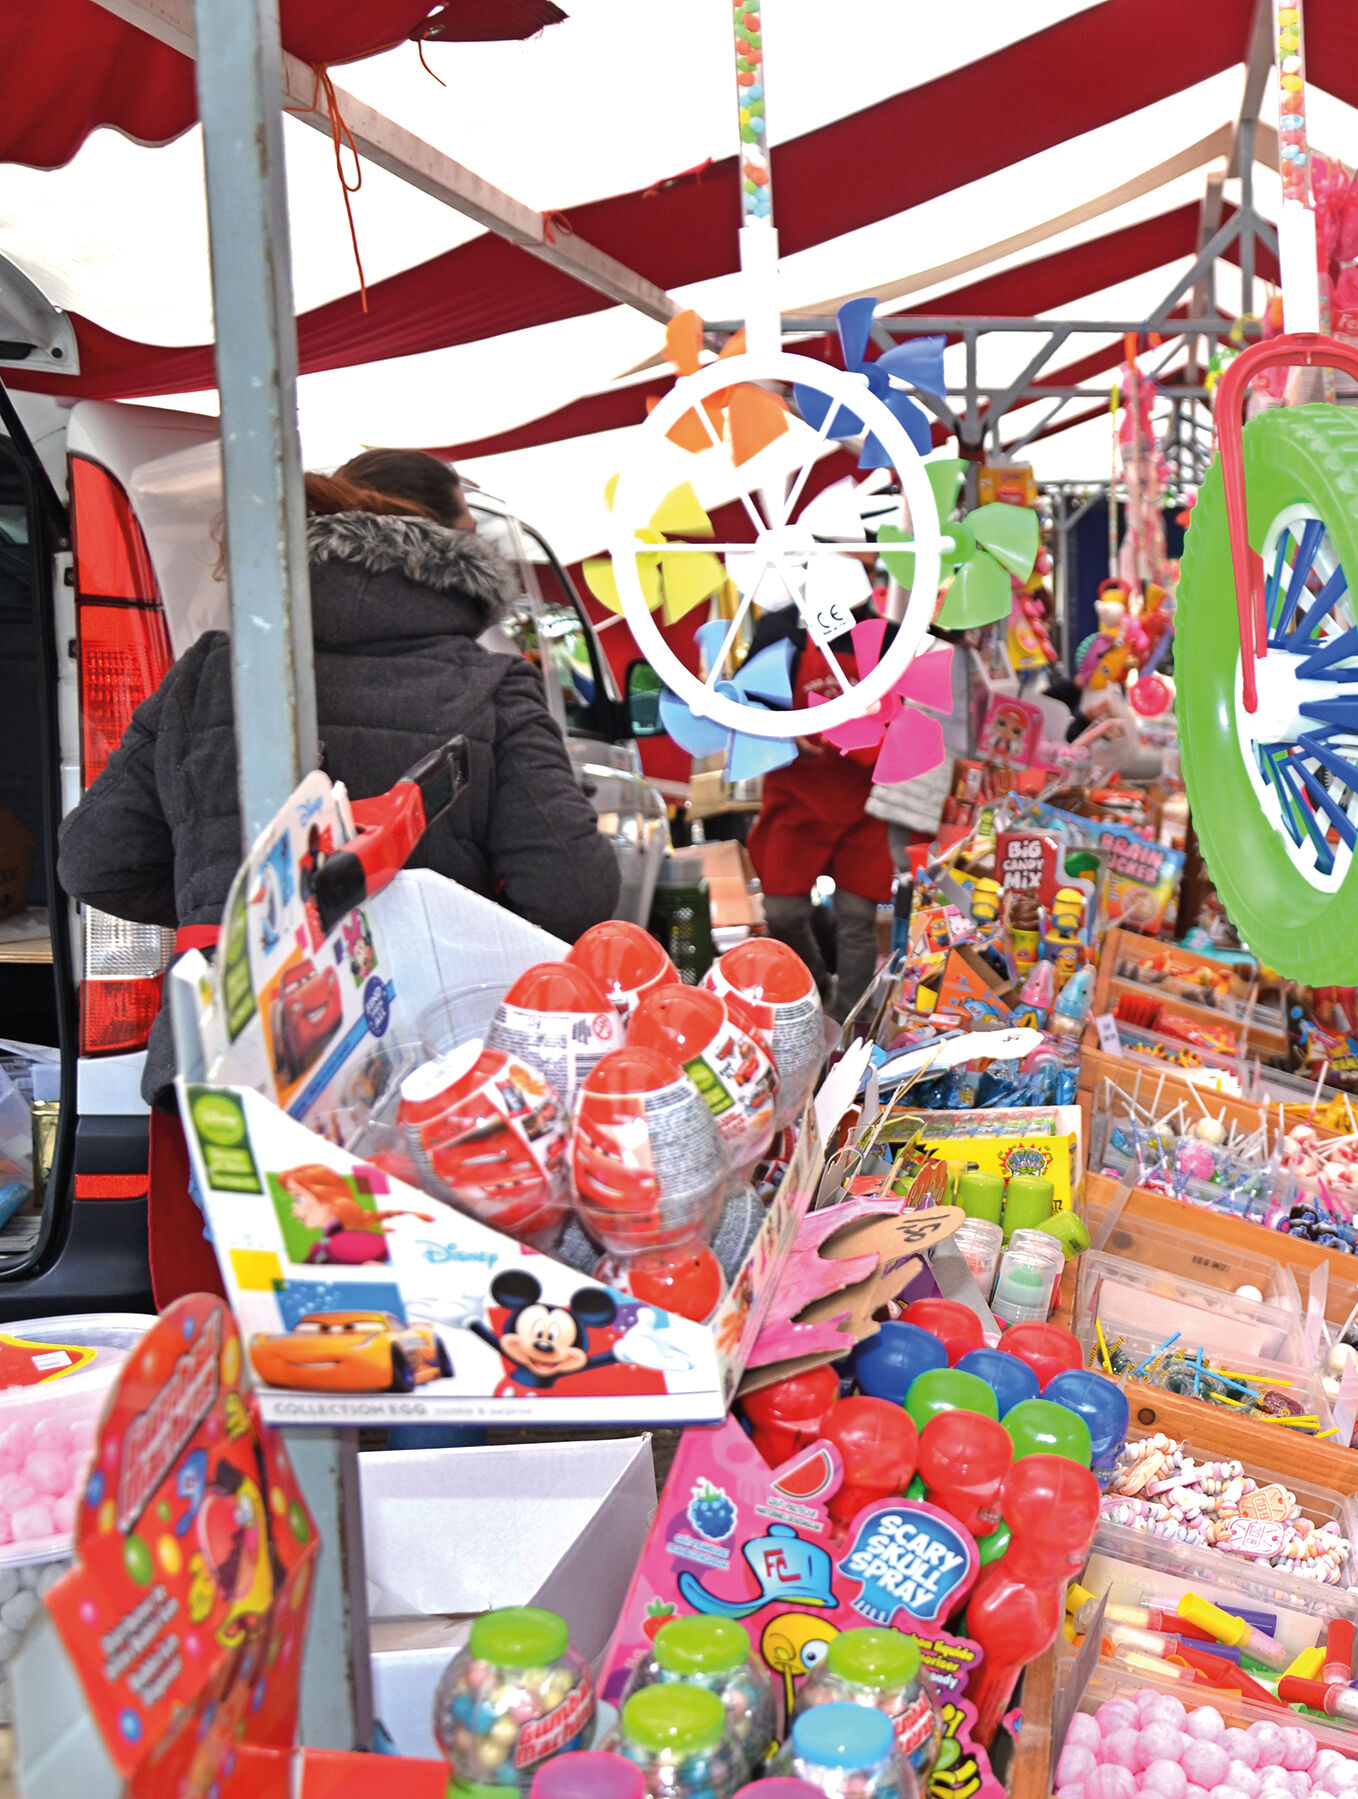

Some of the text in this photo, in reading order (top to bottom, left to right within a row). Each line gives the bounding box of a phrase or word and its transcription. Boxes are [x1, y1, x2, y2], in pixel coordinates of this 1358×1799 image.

[817, 604, 844, 629] CE
[1101, 832, 1166, 869] BRAIN
[1002, 859, 1045, 872] CANDY
[896, 1214, 951, 1243] 1,50
[273, 1402, 428, 1416] COLLECTION EGG
[878, 1515, 964, 1572] SCARY
[763, 1548, 802, 1582] FC
[866, 1535, 941, 1592] SKULL
[849, 1551, 935, 1608] SPRAY
[934, 1640, 975, 1661] liquide
[929, 1672, 958, 1690] andy
